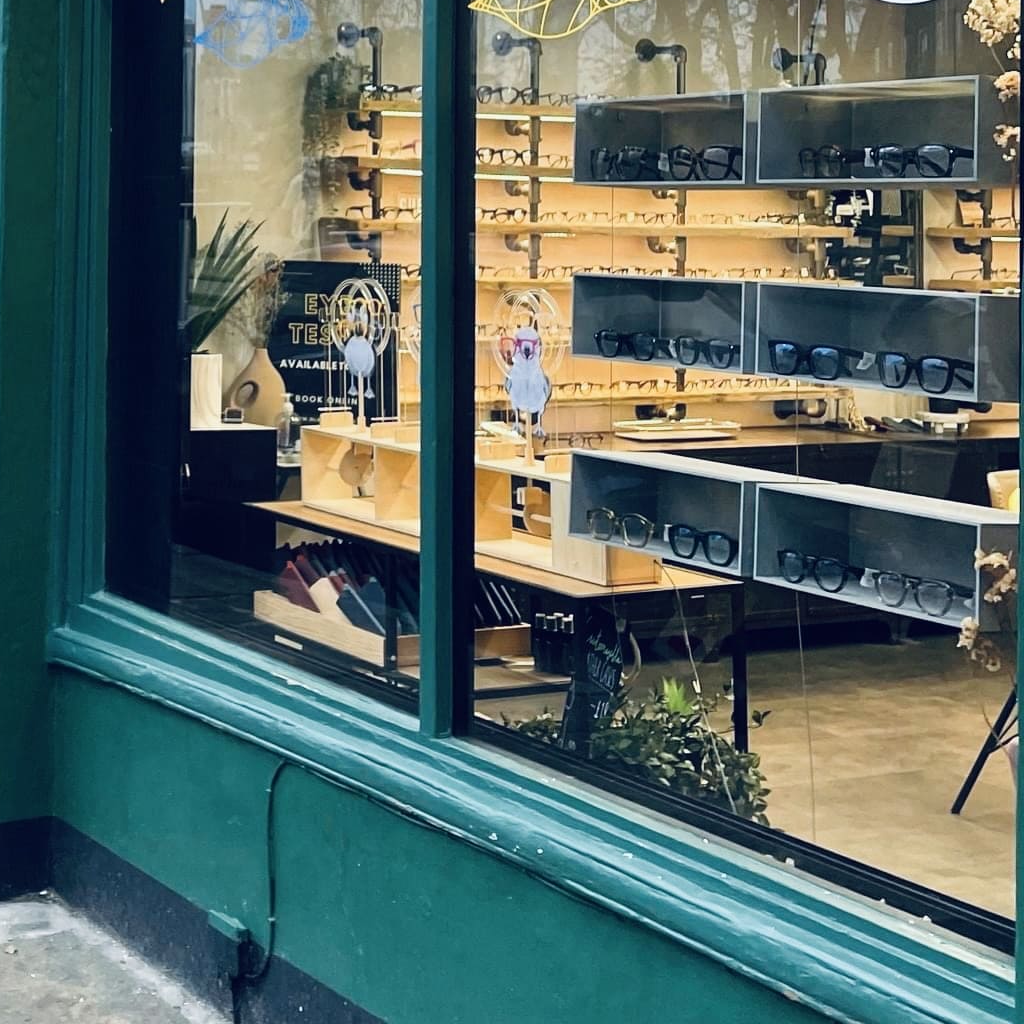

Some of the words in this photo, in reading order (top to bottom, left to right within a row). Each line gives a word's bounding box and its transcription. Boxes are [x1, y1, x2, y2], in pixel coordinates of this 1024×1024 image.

[288, 323, 334, 346] TES
[279, 359, 338, 371] AVAILABLE
[295, 394, 323, 404] BOOK
[327, 396, 358, 406] ONLIN
